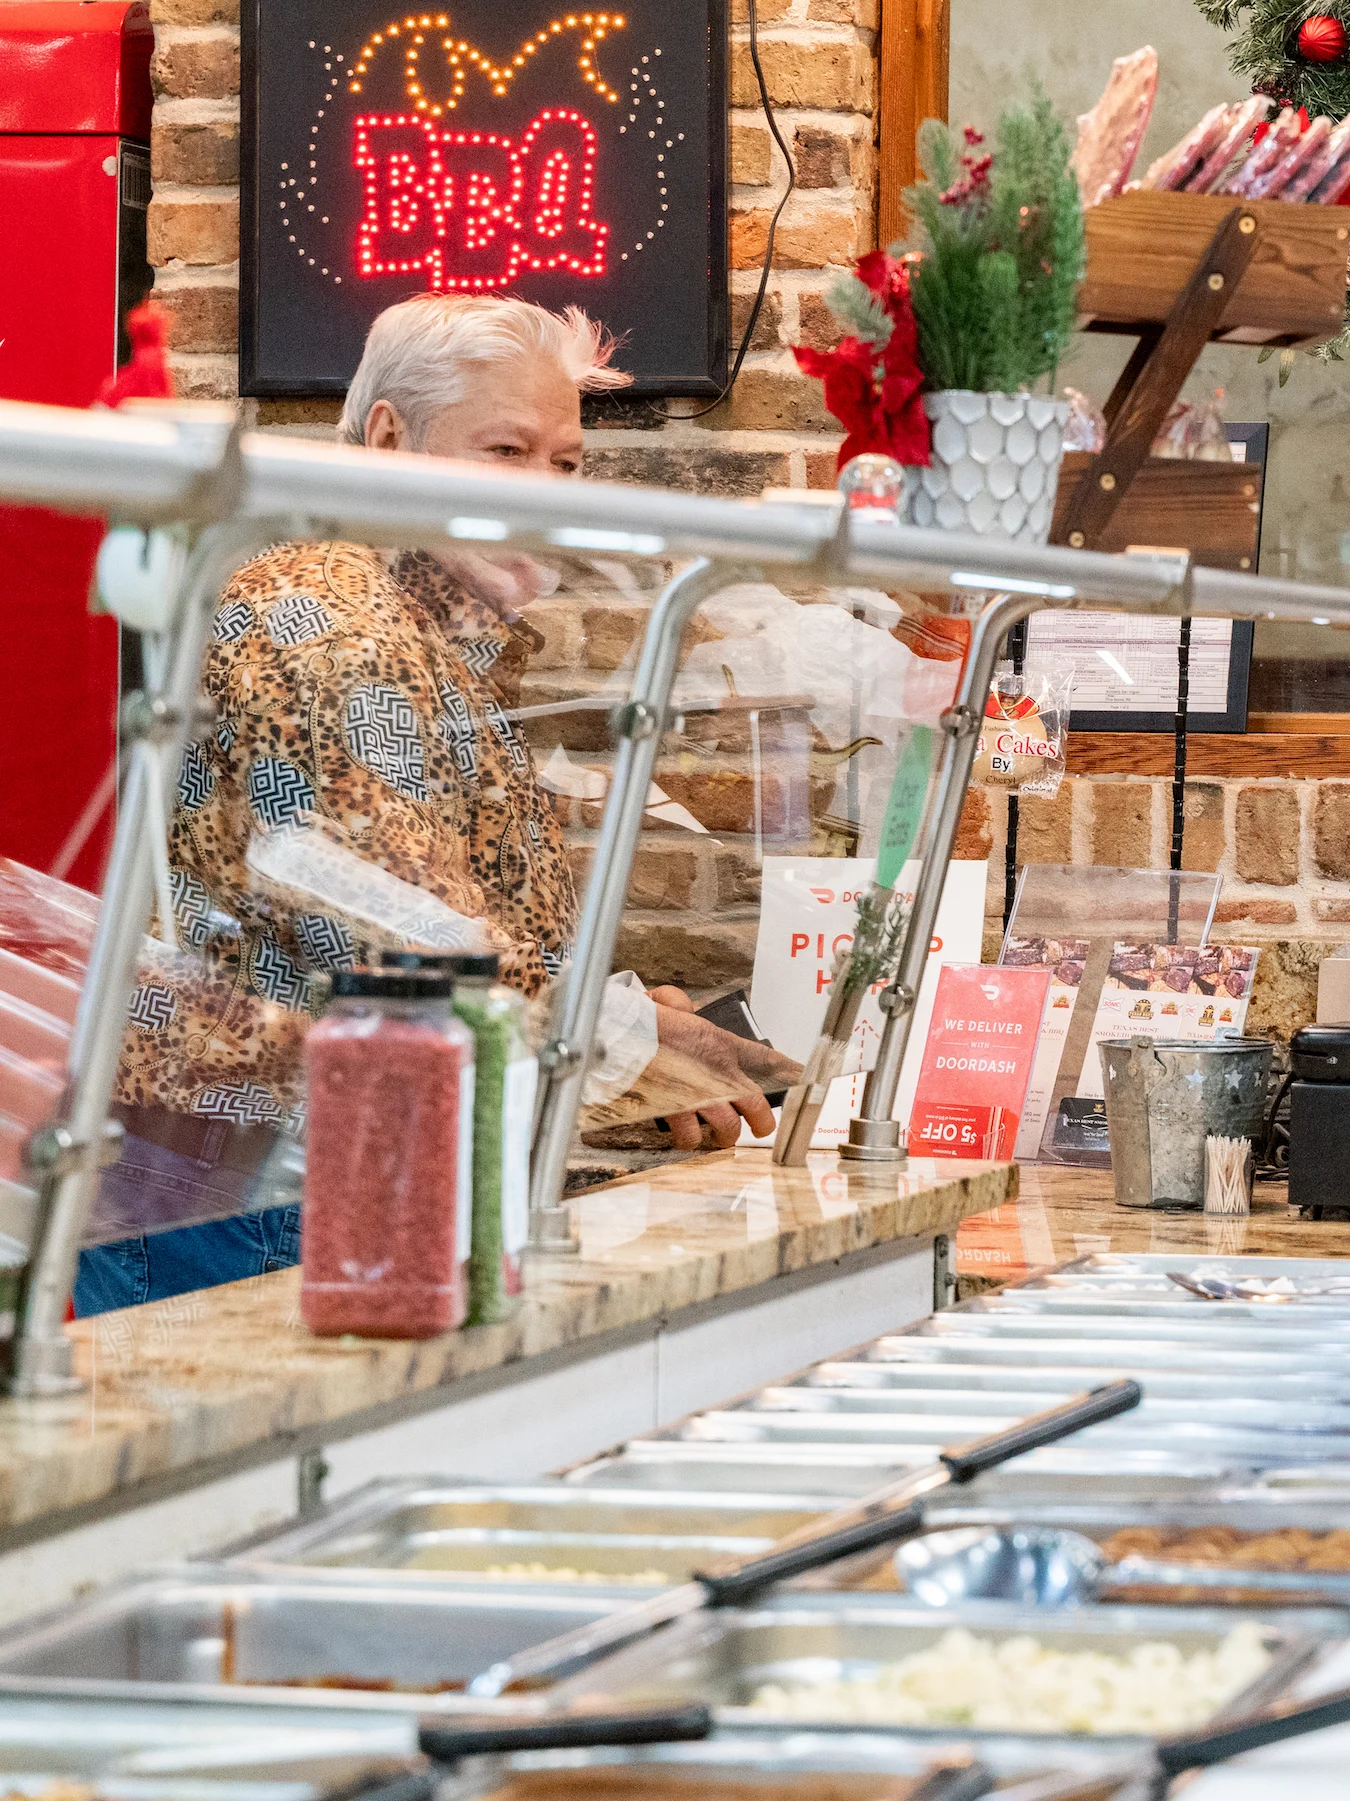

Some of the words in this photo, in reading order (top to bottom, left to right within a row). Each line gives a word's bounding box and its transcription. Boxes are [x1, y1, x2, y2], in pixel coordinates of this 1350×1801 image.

[355, 109, 610, 290] BBQ
[997, 734, 1056, 758] Cakes
[992, 758, 1010, 772] By
[986, 776, 1016, 785] Cheryl
[945, 1019, 964, 1030] WE
[968, 1020, 1023, 1034] DELIVER
[936, 1056, 1016, 1074] DOORDASH
[920, 1122, 957, 1141] OFF
[960, 1124, 977, 1145] $5
